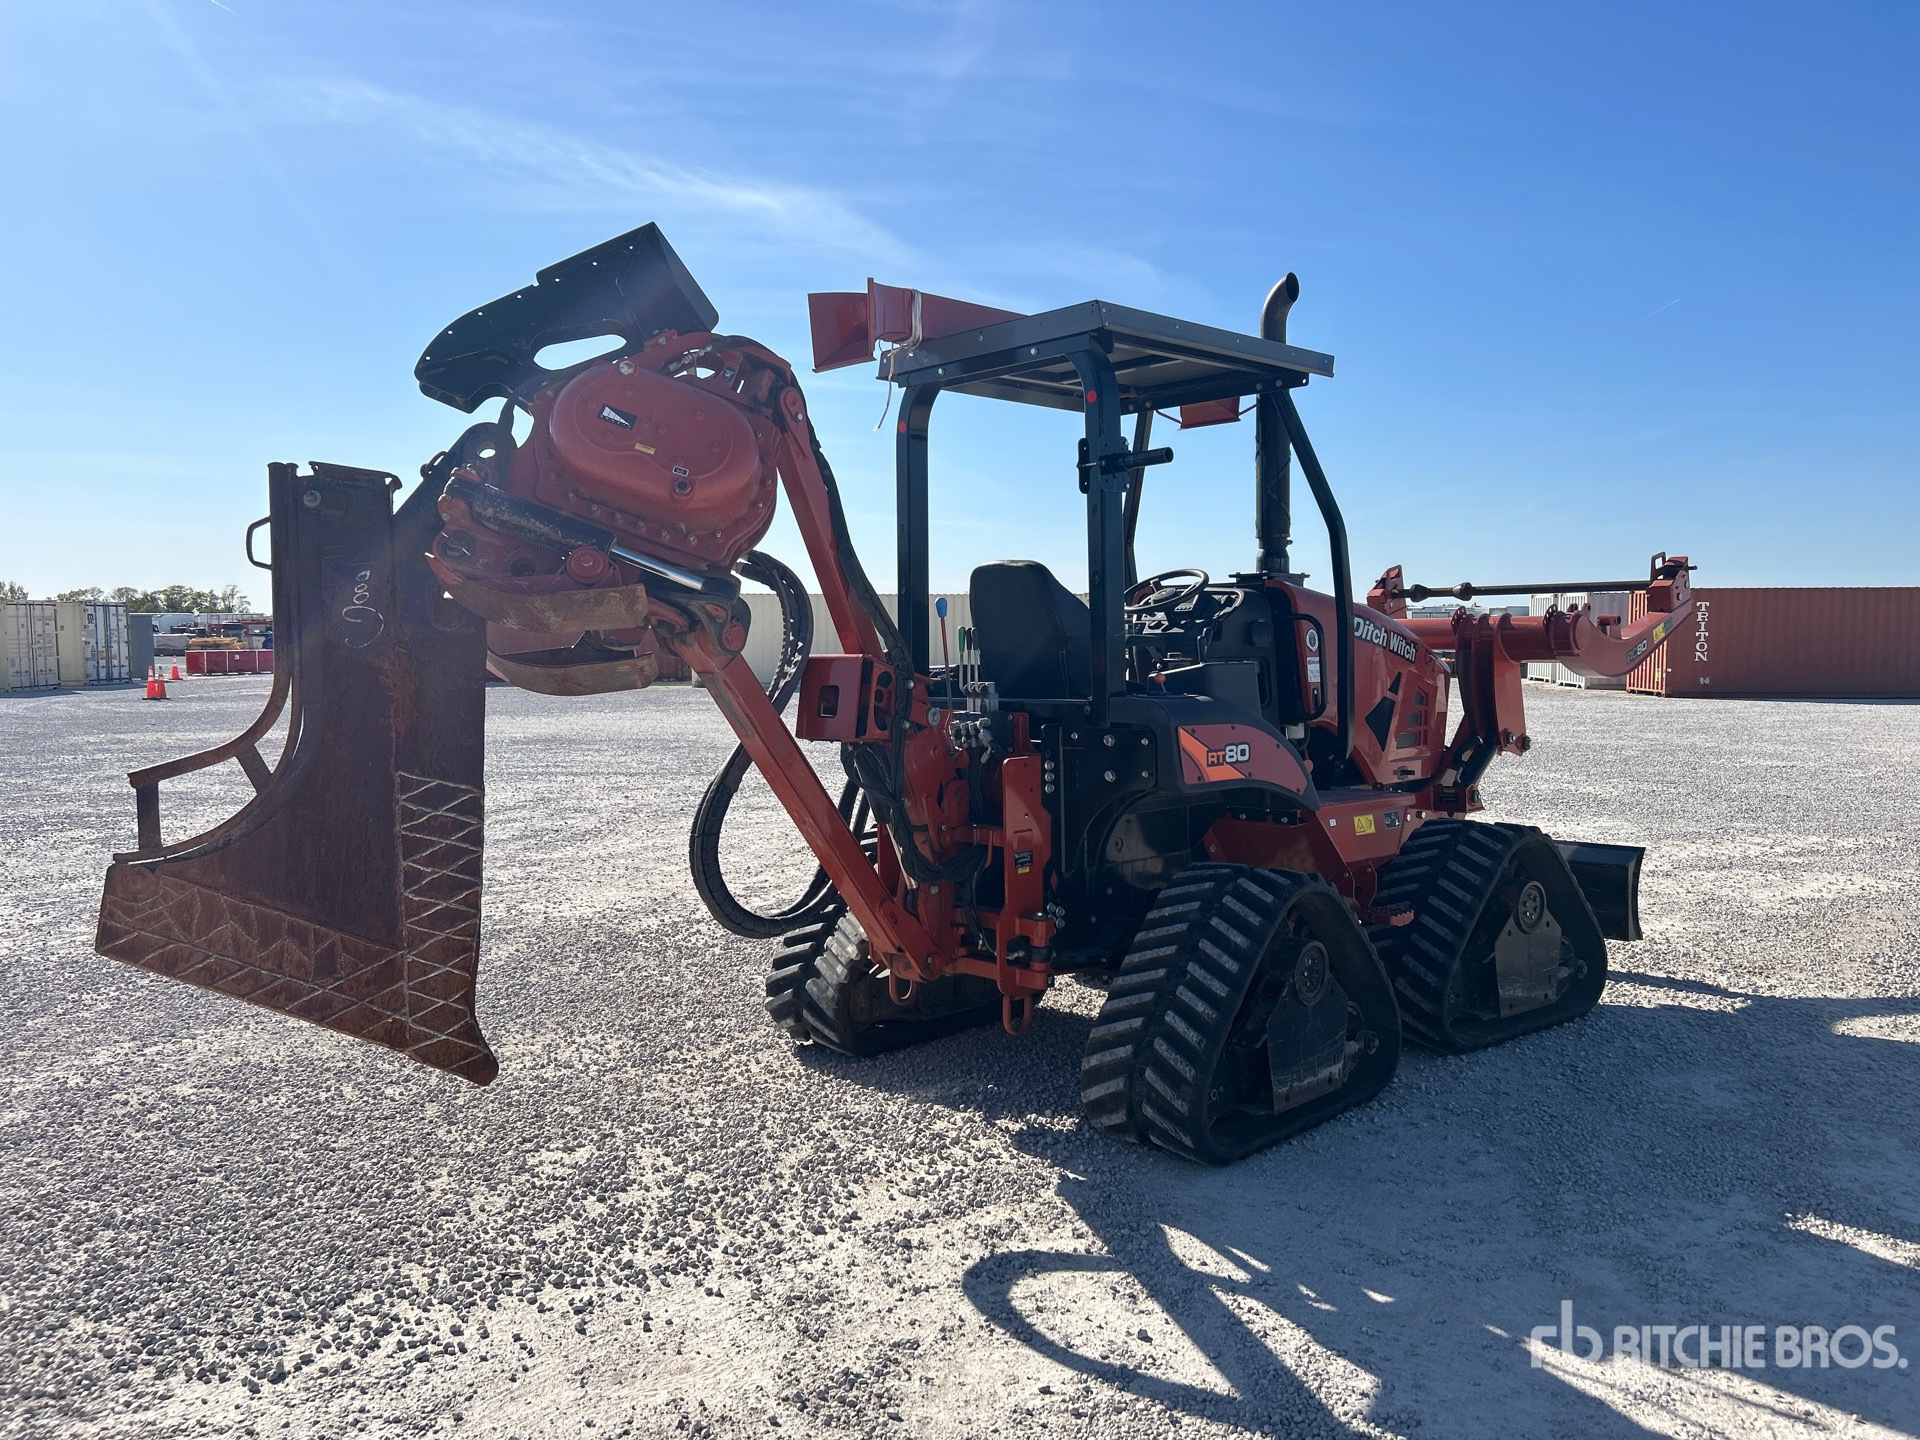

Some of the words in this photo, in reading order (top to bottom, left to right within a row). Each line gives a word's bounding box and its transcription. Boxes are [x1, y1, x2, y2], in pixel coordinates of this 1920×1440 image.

[1353, 616, 1388, 648] Ditch
[1389, 631, 1417, 662] Witch
[1695, 602, 1709, 662] TRITON
[1207, 743, 1250, 765] RT80
